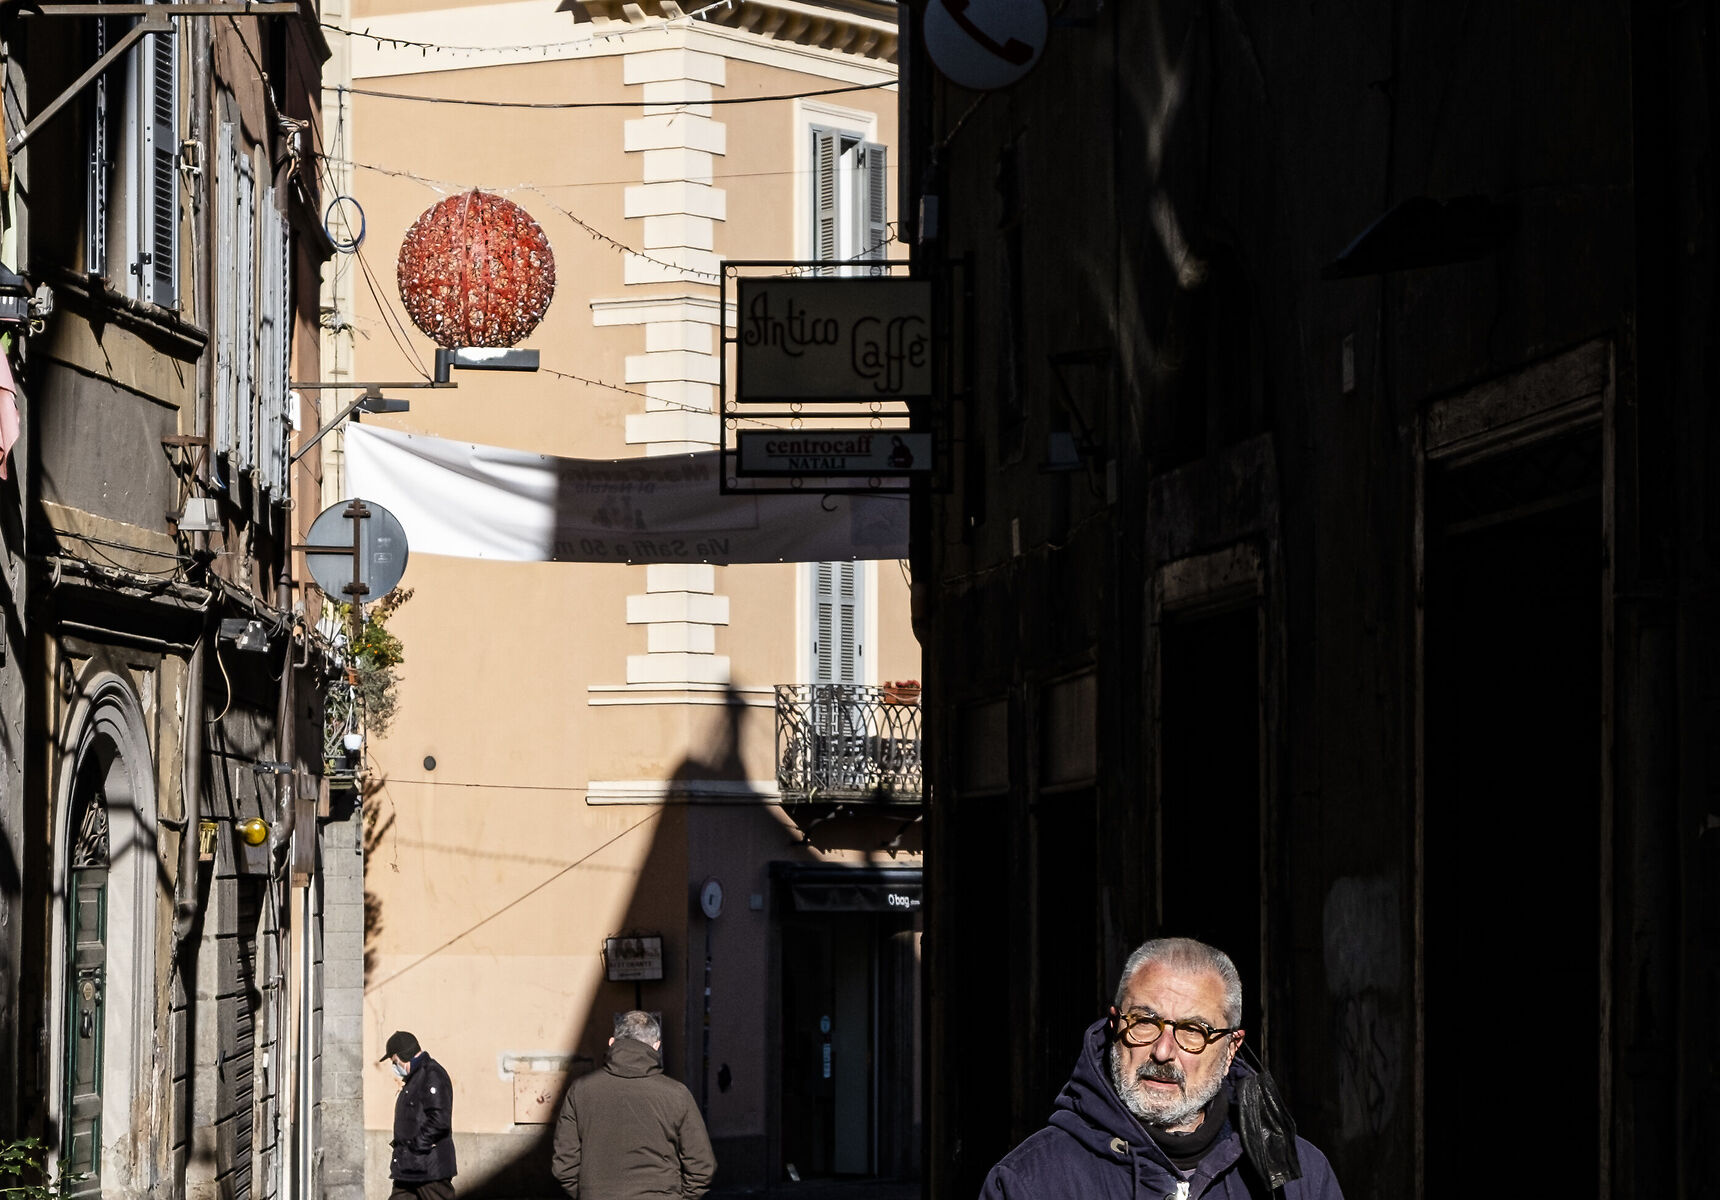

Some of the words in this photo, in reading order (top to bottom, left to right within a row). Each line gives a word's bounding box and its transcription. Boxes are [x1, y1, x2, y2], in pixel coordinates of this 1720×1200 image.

[744, 291, 839, 357] Antico
[851, 315, 929, 393] Caffè
[789, 458, 846, 470] NATALI
